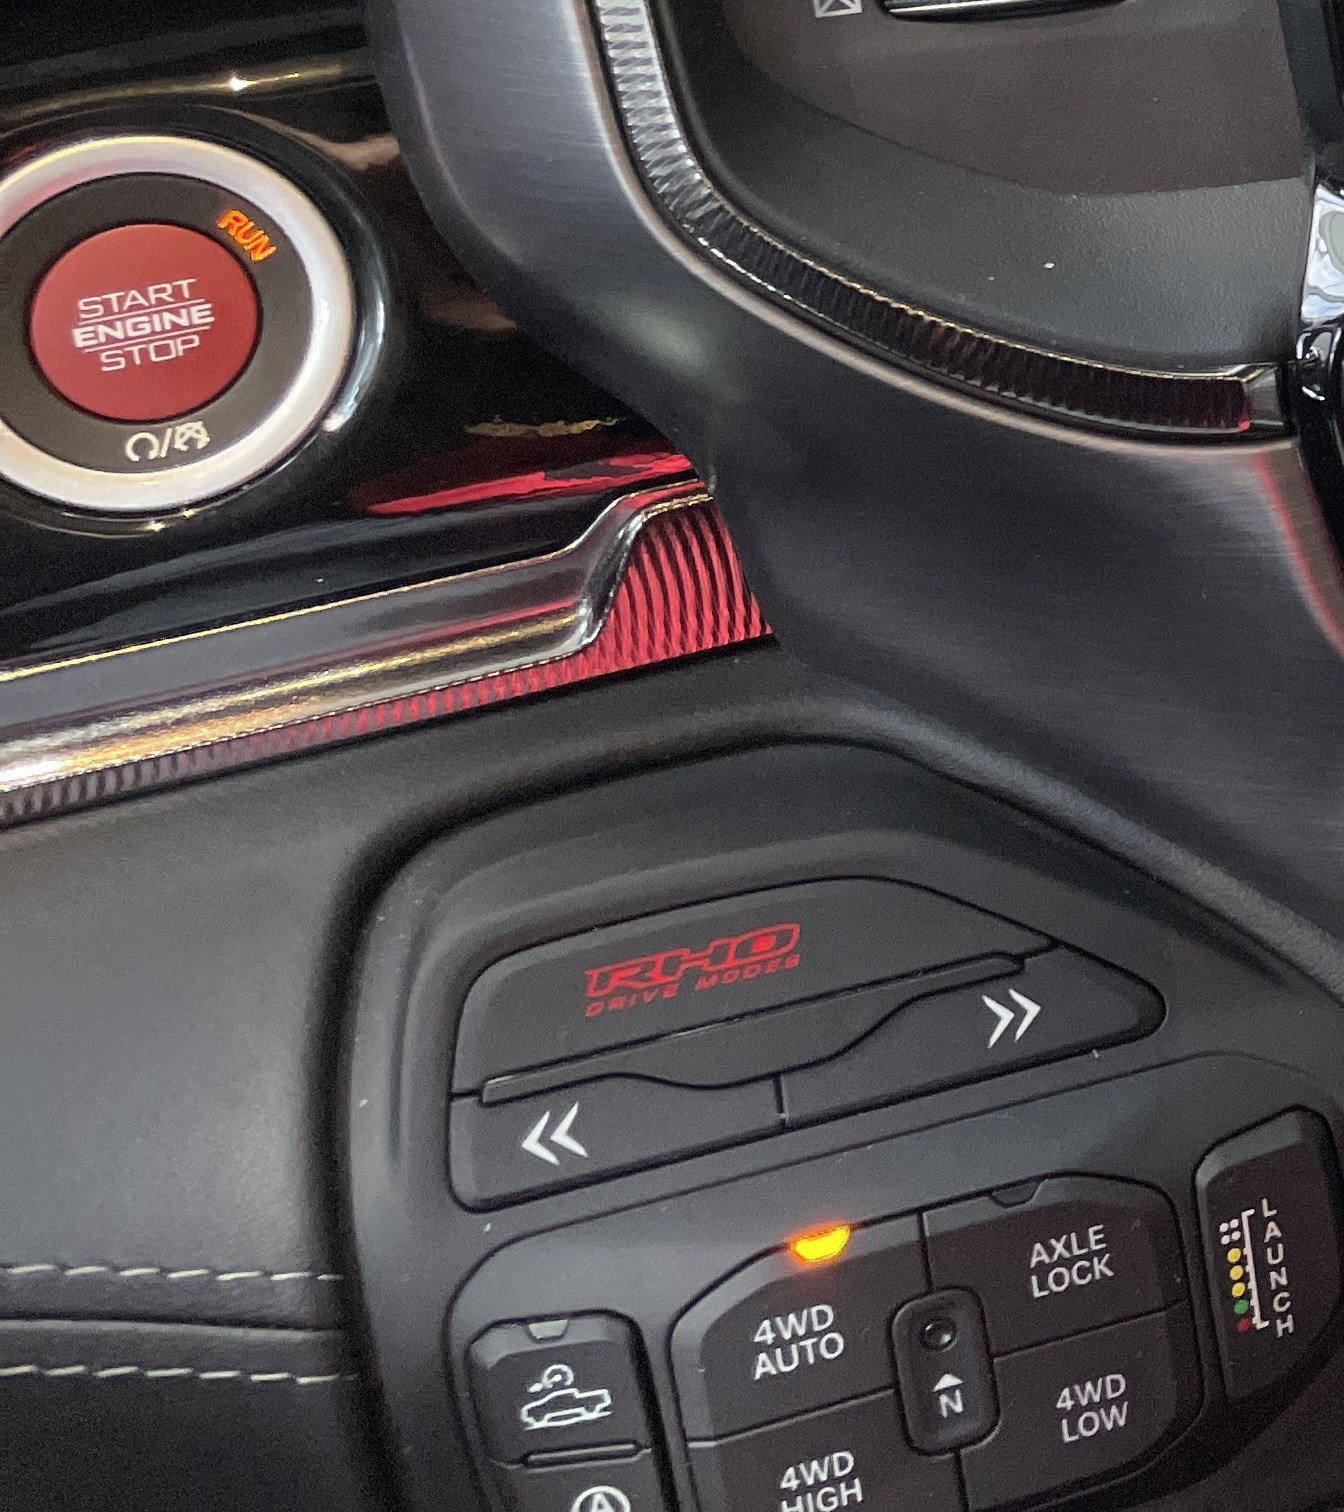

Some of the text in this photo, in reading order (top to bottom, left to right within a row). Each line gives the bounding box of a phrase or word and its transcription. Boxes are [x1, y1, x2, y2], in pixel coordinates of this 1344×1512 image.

[216, 209, 277, 262] RUN
[78, 278, 197, 320] START
[72, 303, 216, 349] ENGINE
[100, 335, 201, 372] STOP
[1030, 1224, 1107, 1269] AXLE
[1261, 1197, 1295, 1337] LAUNCH
[1030, 1253, 1114, 1298] LOCK
[753, 1303, 834, 1346] 4WD
[753, 1332, 845, 1381] AUTO
[938, 1390, 964, 1418] N
[1056, 1373, 1127, 1410] 4WD
[1061, 1401, 1129, 1444] LOW
[780, 1451, 855, 1491] 4WD
[781, 1478, 863, 1512] HIGH
